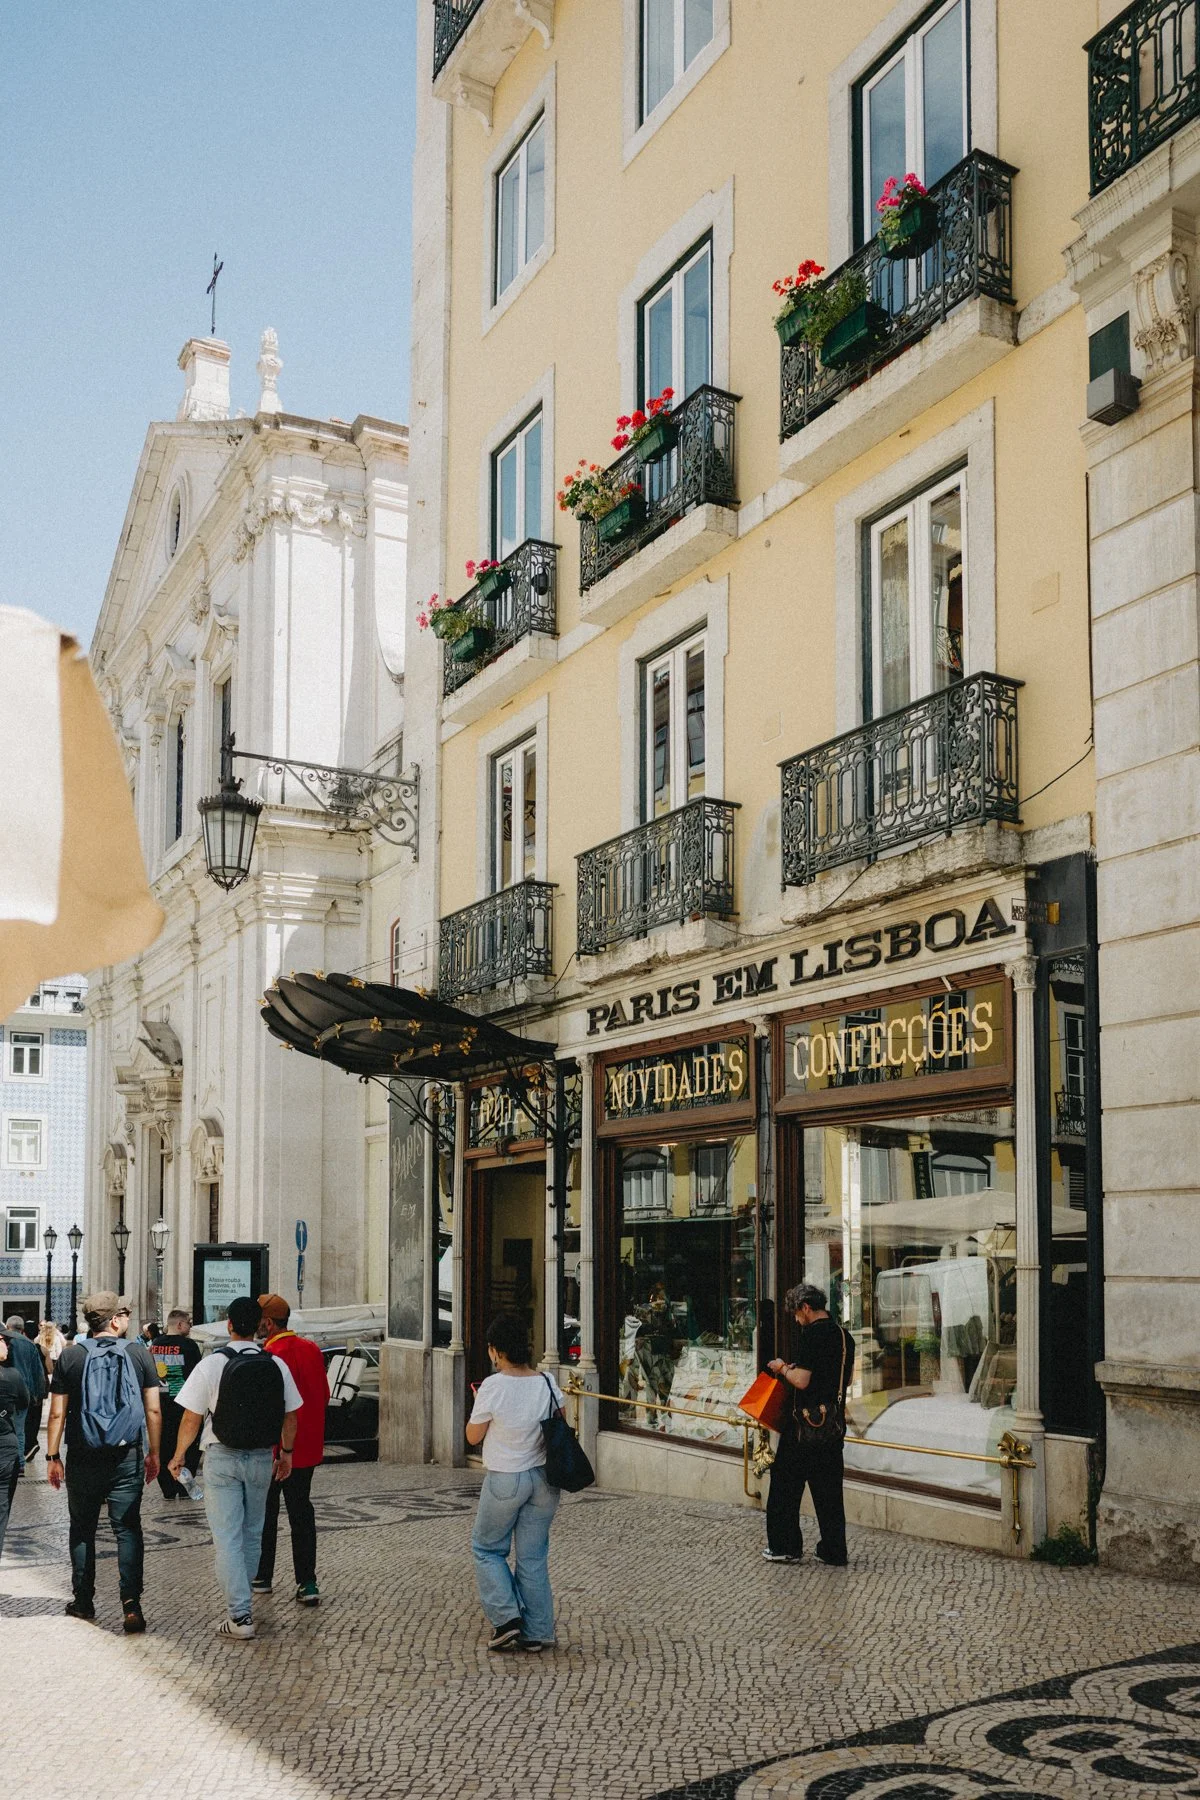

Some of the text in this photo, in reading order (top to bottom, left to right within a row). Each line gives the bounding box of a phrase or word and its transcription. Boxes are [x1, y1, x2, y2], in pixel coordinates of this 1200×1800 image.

[587, 898, 1016, 1036] PARIS EM LISBOA
[610, 1049, 743, 1110] NOVIDADES
